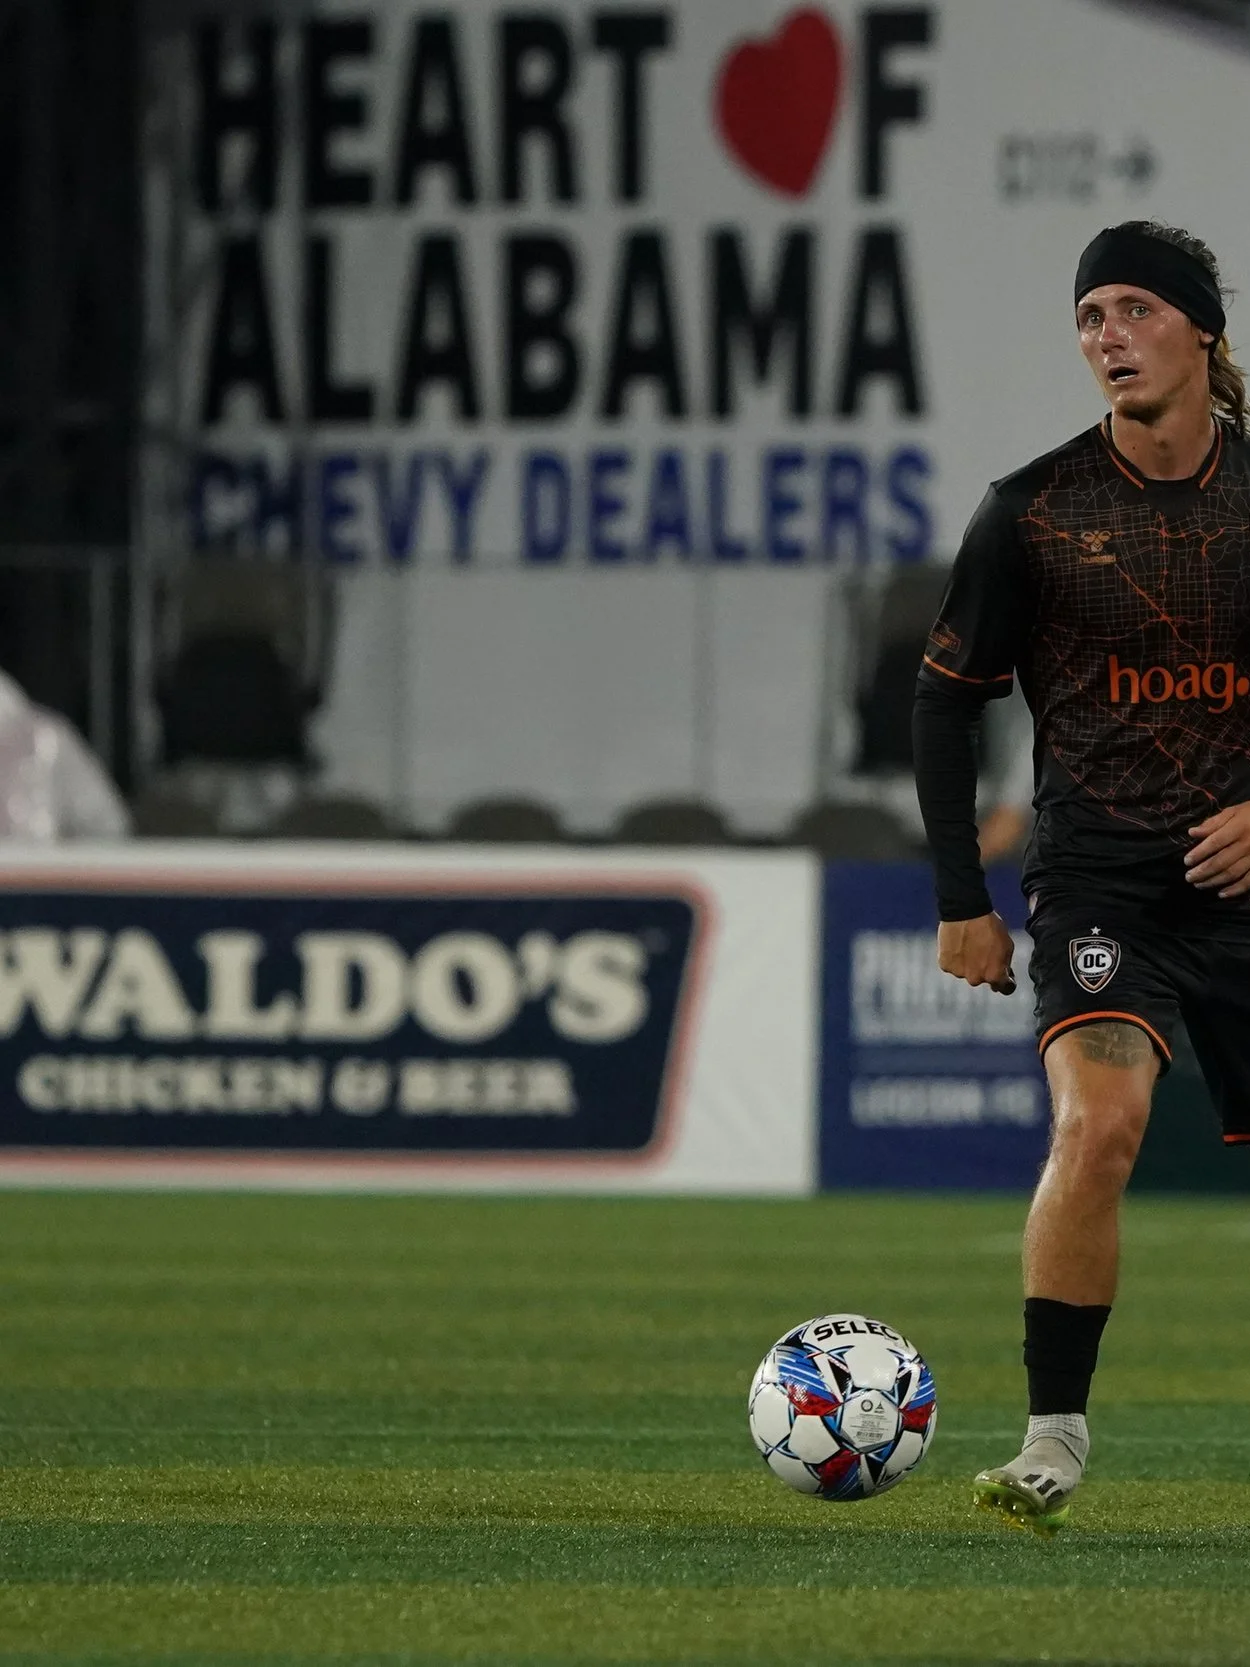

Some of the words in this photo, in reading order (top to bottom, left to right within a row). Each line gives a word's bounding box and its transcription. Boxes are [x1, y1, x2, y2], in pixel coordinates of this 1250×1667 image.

[200, 12, 672, 211] HEART
[199, 222, 926, 425] ALABAMA
[192, 443, 492, 567] CHEVY
[521, 443, 937, 567] DEALERS
[1108, 654, 1250, 714] hoag.
[0, 926, 649, 1045] WALDO'S
[1083, 953, 1106, 969] OC
[16, 1055, 325, 1114] CHICKEN
[330, 1056, 394, 1116] &
[397, 1057, 579, 1115] BEER
